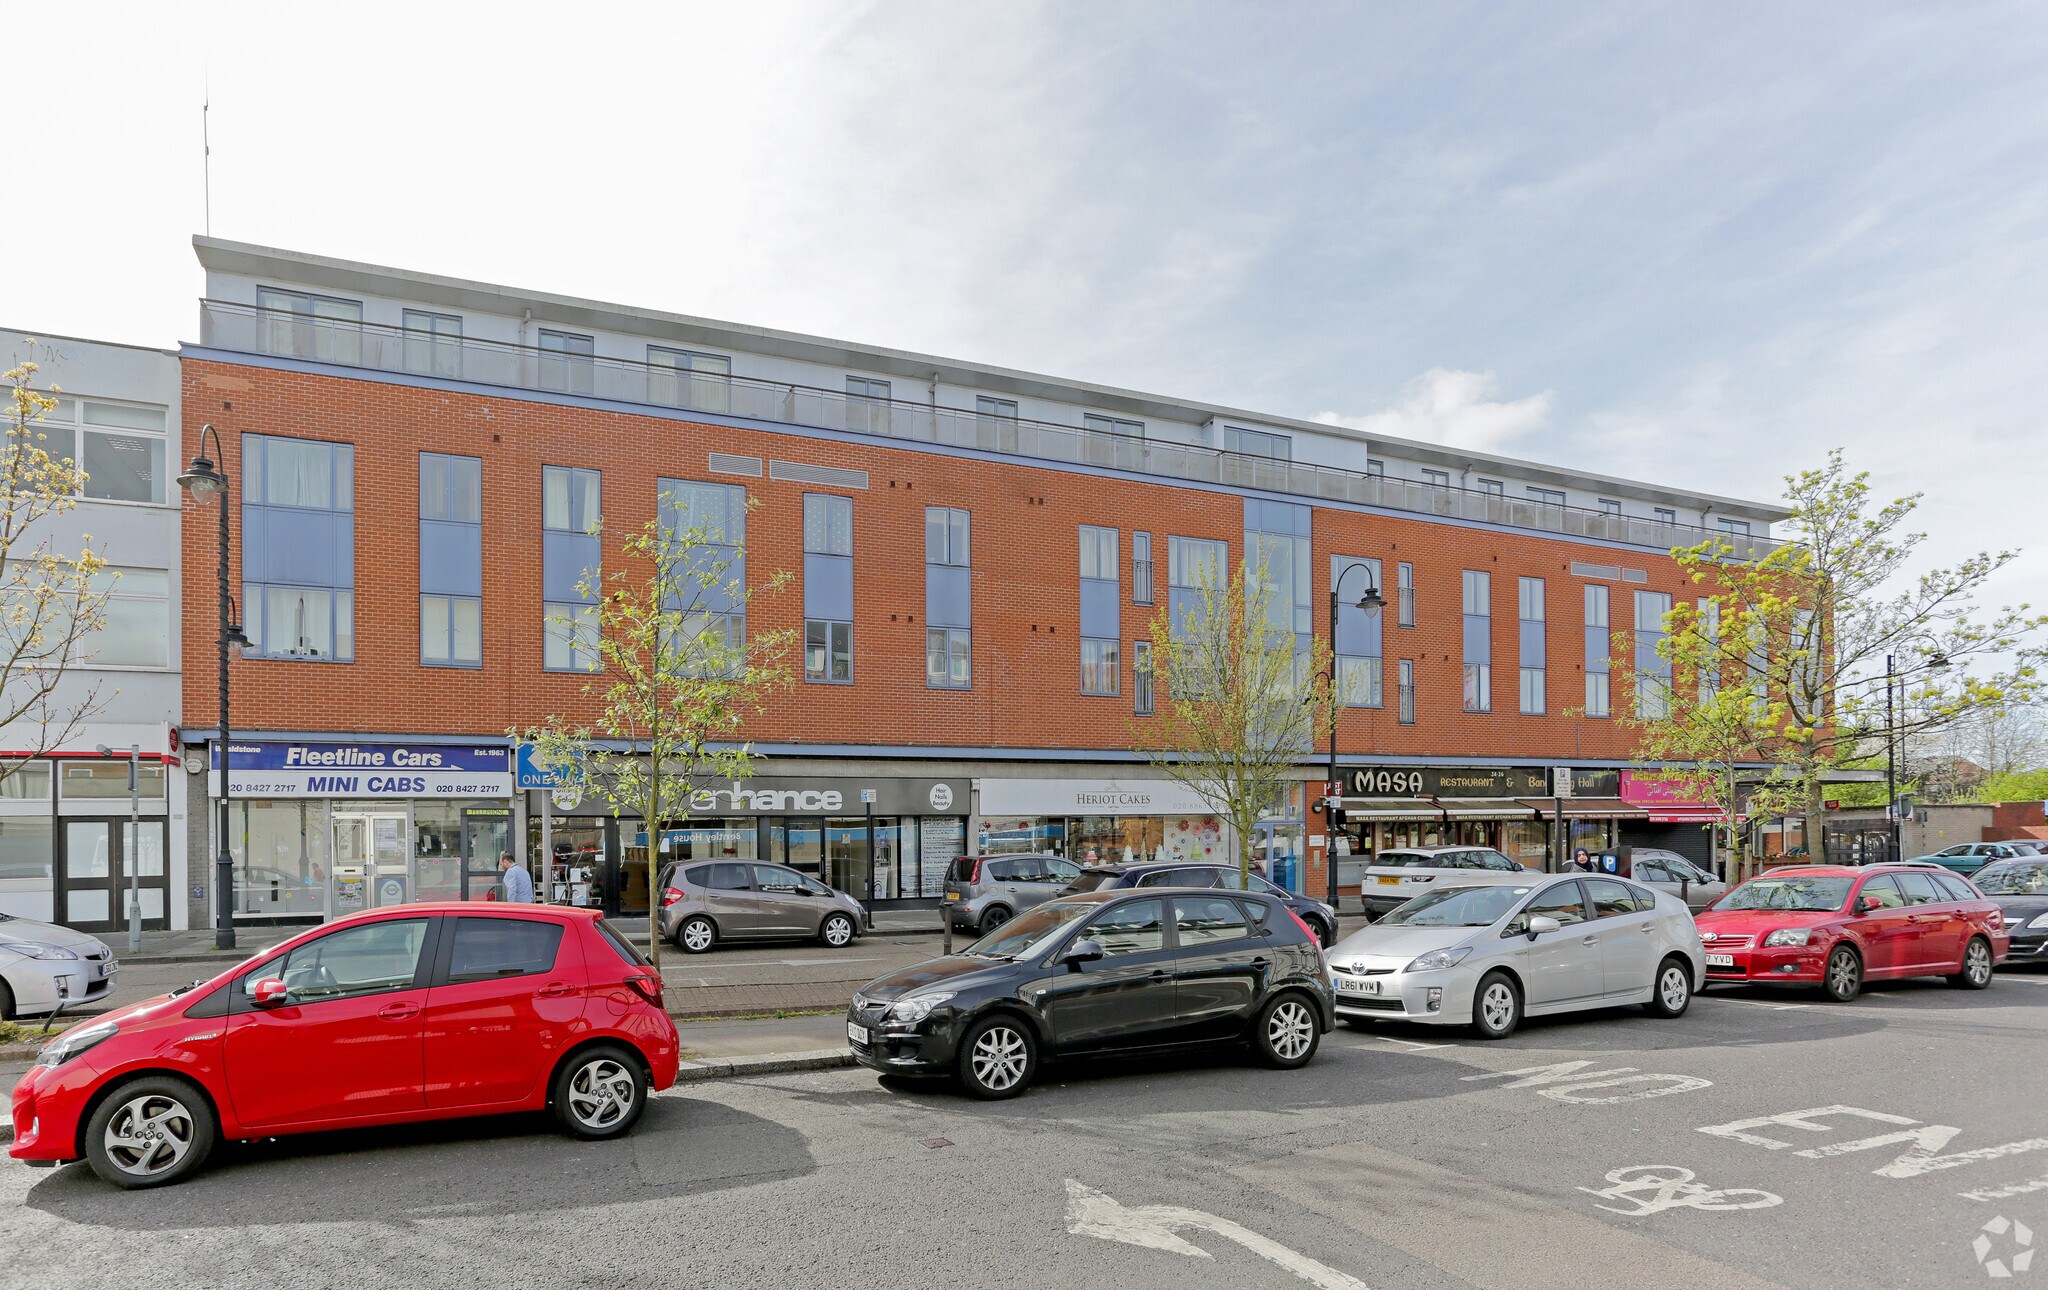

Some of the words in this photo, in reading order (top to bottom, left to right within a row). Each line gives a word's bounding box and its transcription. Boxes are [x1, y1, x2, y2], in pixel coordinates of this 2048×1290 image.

[215, 745, 261, 753] Waldstone
[286, 747, 386, 766] Fleetline
[392, 749, 442, 767] Cars
[307, 777, 359, 792] MINI
[367, 777, 426, 792] CABS
[522, 774, 550, 785] ONE
[1355, 771, 1423, 792] MASA
[1440, 777, 1494, 787] RESTAURANT
[1506, 778, 1514, 787] &
[1578, 777, 1595, 787] Hall
[227, 784, 243, 792] 20
[246, 784, 271, 792] 8427
[274, 784, 297, 792] 2717
[436, 785, 453, 793] 020
[456, 785, 478, 793] 8427
[480, 785, 500, 793] 2717
[691, 782, 843, 811] enhance
[1340, 981, 1357, 990] LR61
[1359, 982, 1374, 991] WVM
